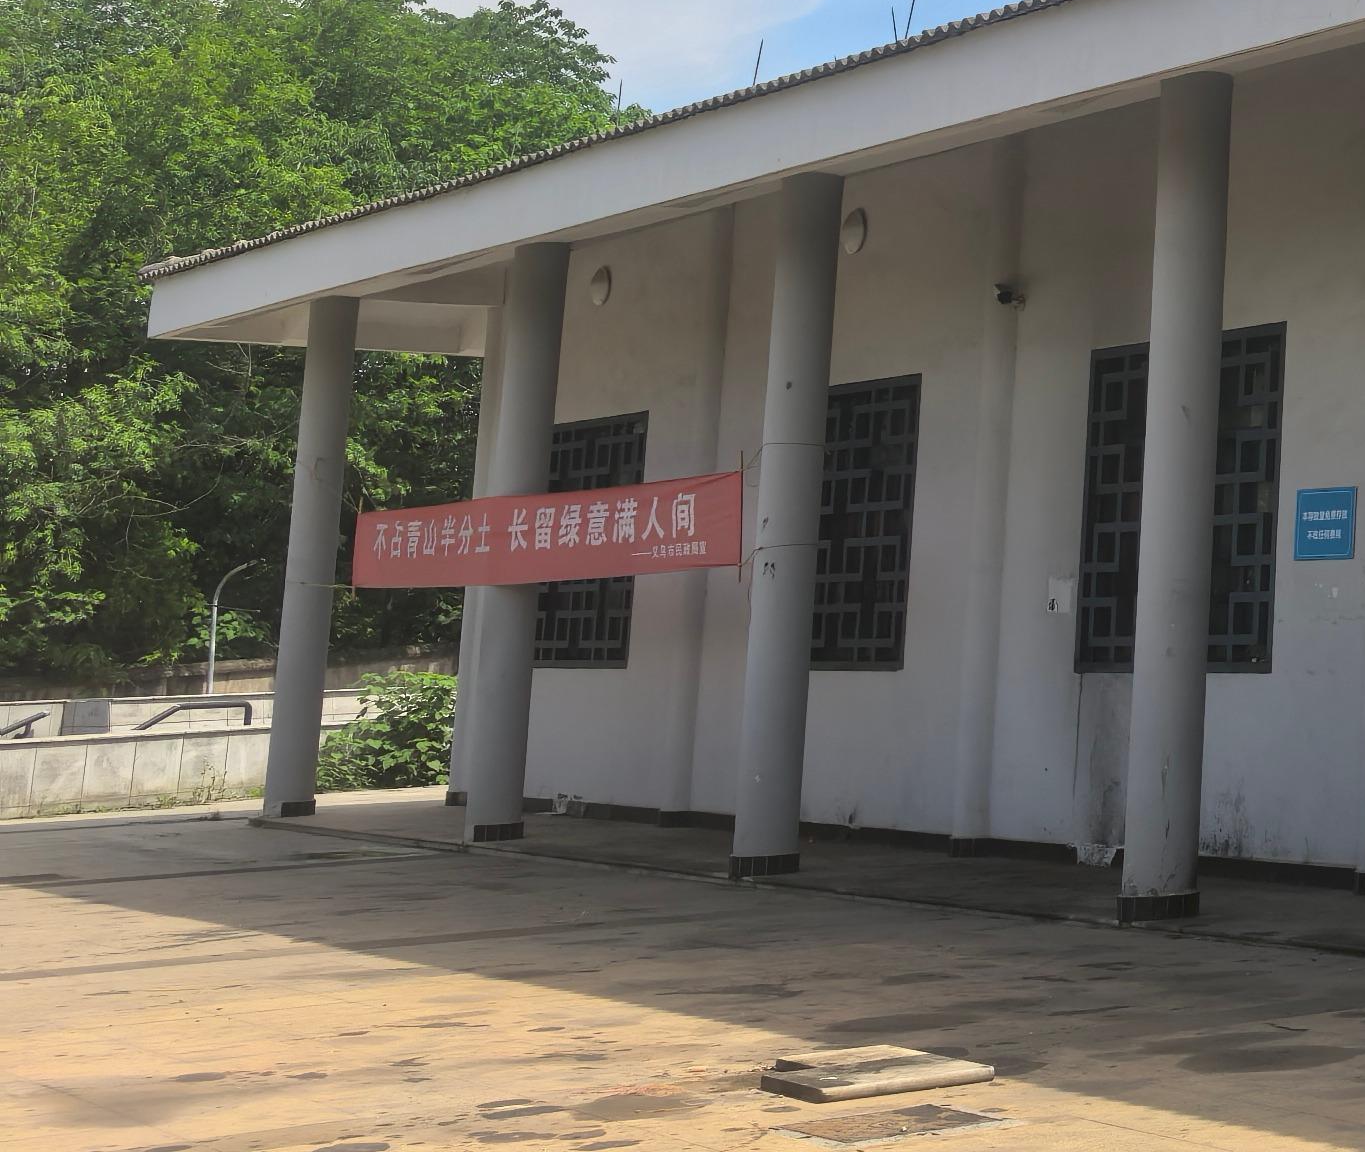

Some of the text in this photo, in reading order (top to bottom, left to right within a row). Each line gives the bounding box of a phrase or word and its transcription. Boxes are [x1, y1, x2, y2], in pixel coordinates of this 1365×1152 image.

[373, 491, 697, 561] 不占青山半分土 长留绿意满人间
